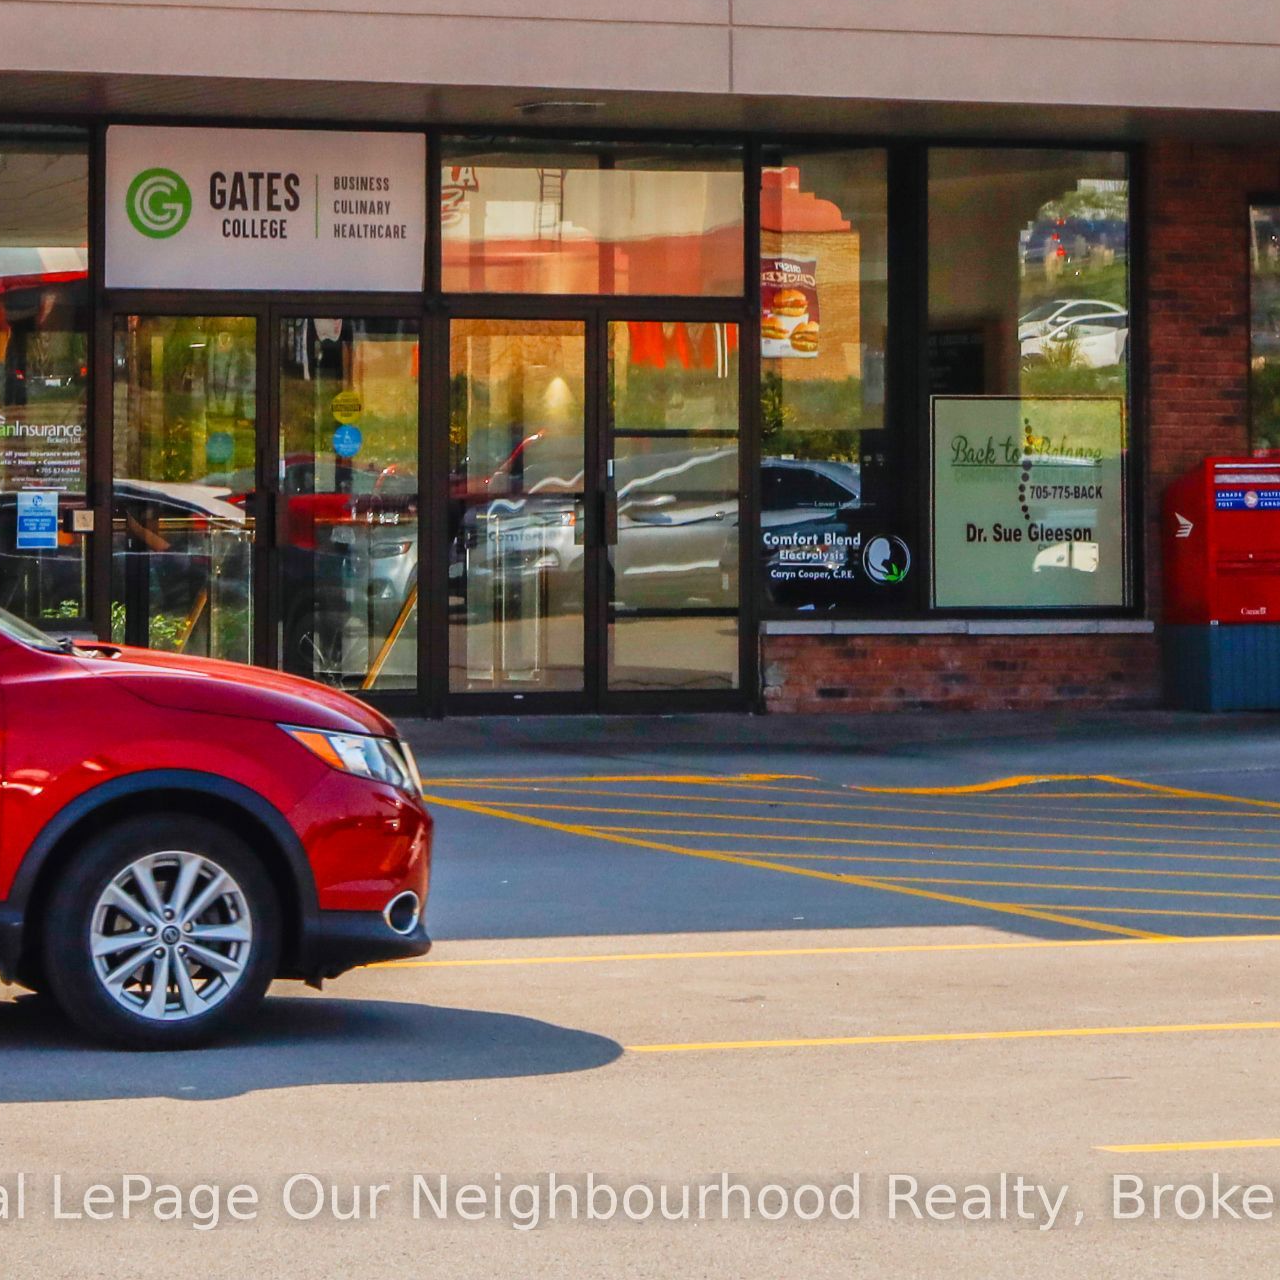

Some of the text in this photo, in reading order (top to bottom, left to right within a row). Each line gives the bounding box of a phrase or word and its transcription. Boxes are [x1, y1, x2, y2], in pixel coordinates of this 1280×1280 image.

[209, 171, 301, 212] GATES
[333, 176, 390, 192] BUSINESS
[333, 200, 391, 215] CULINARY
[222, 219, 288, 239] COLLEGE
[333, 224, 407, 239] HEALTHCARE
[951, 435, 996, 463] Back
[999, 436, 1020, 463] to
[1030, 485, 1102, 499] 705-775-BACK
[763, 532, 861, 545] Comfort Blend
[966, 523, 1092, 542] Dr. Sue Gleeson
[779, 550, 845, 561] Electrolysis
[771, 570, 854, 580] Caryn Cooper, C.P.E.
